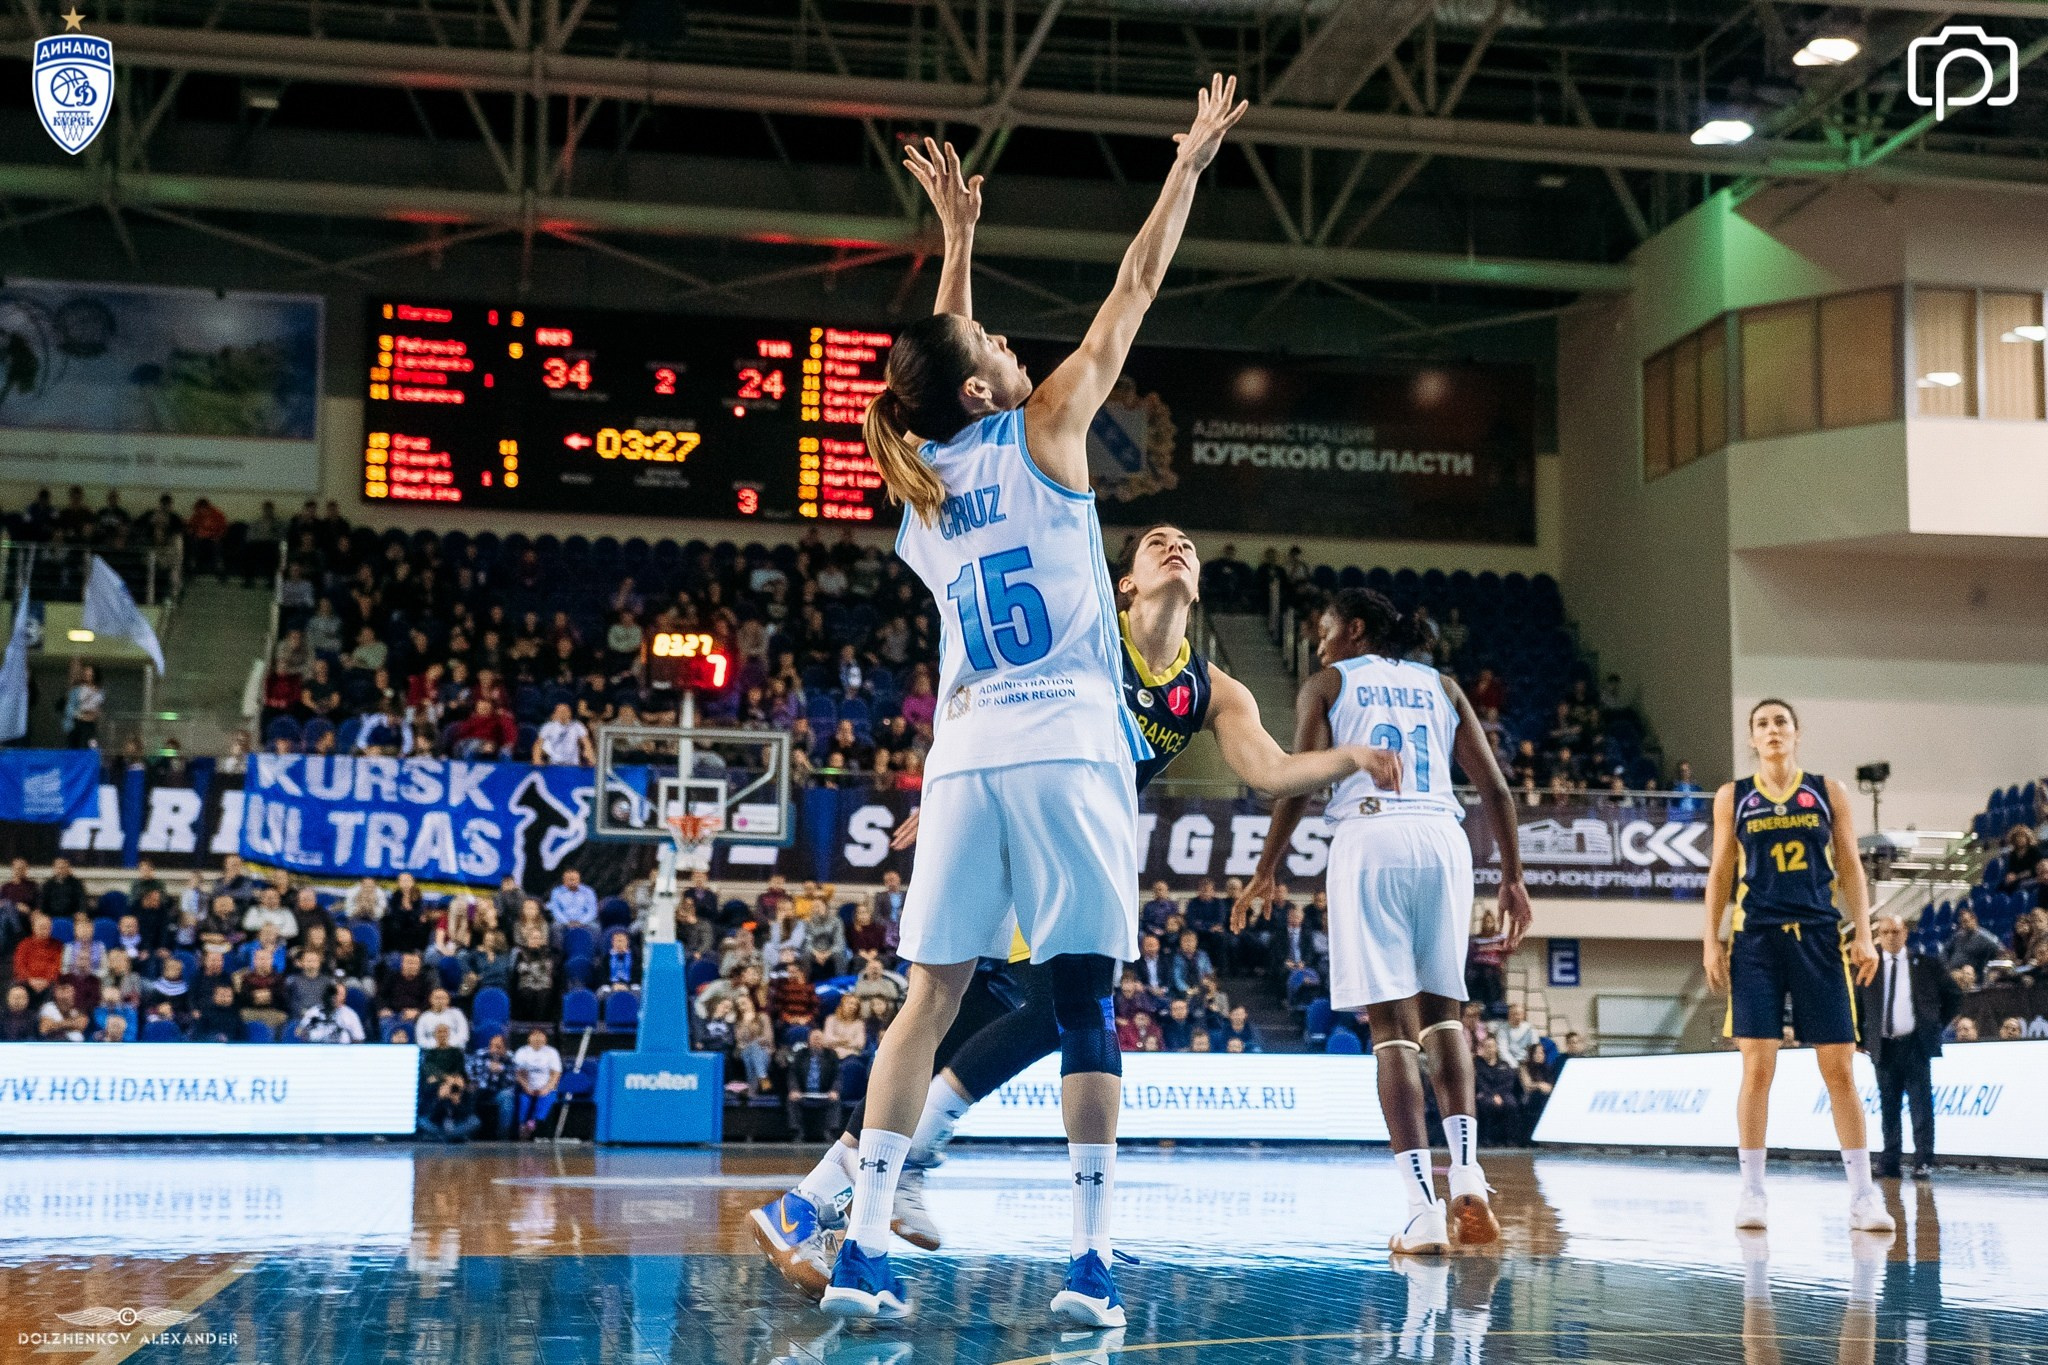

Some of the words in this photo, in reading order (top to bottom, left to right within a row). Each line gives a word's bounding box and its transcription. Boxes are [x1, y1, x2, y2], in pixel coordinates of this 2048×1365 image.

[543, 358, 592, 390] 34
[654, 368, 676, 394] 2
[738, 368, 785, 399] 24
[596, 428, 701, 462] 03:27
[1193, 442, 1330, 470] КУРСКОЙ
[1336, 449, 1474, 476] ОБЛАСТИ
[737, 488, 758, 514] 3
[938, 484, 1007, 541] CRUZ
[947, 545, 1053, 672] 15
[706, 655, 727, 687] 7
[979, 678, 1074, 695] ADMINISTRATION
[993, 692, 1030, 706] KURSK
[1032, 689, 1076, 701] REGION
[1357, 686, 1434, 710] CHARLES
[1133, 713, 1185, 754] BAHÇE
[256, 752, 497, 811] KURSK
[246, 792, 501, 876] ULTRAS
[1770, 840, 1808, 873] 12
[1553, 951, 1578, 984] E
[624, 1070, 699, 1091] molten
